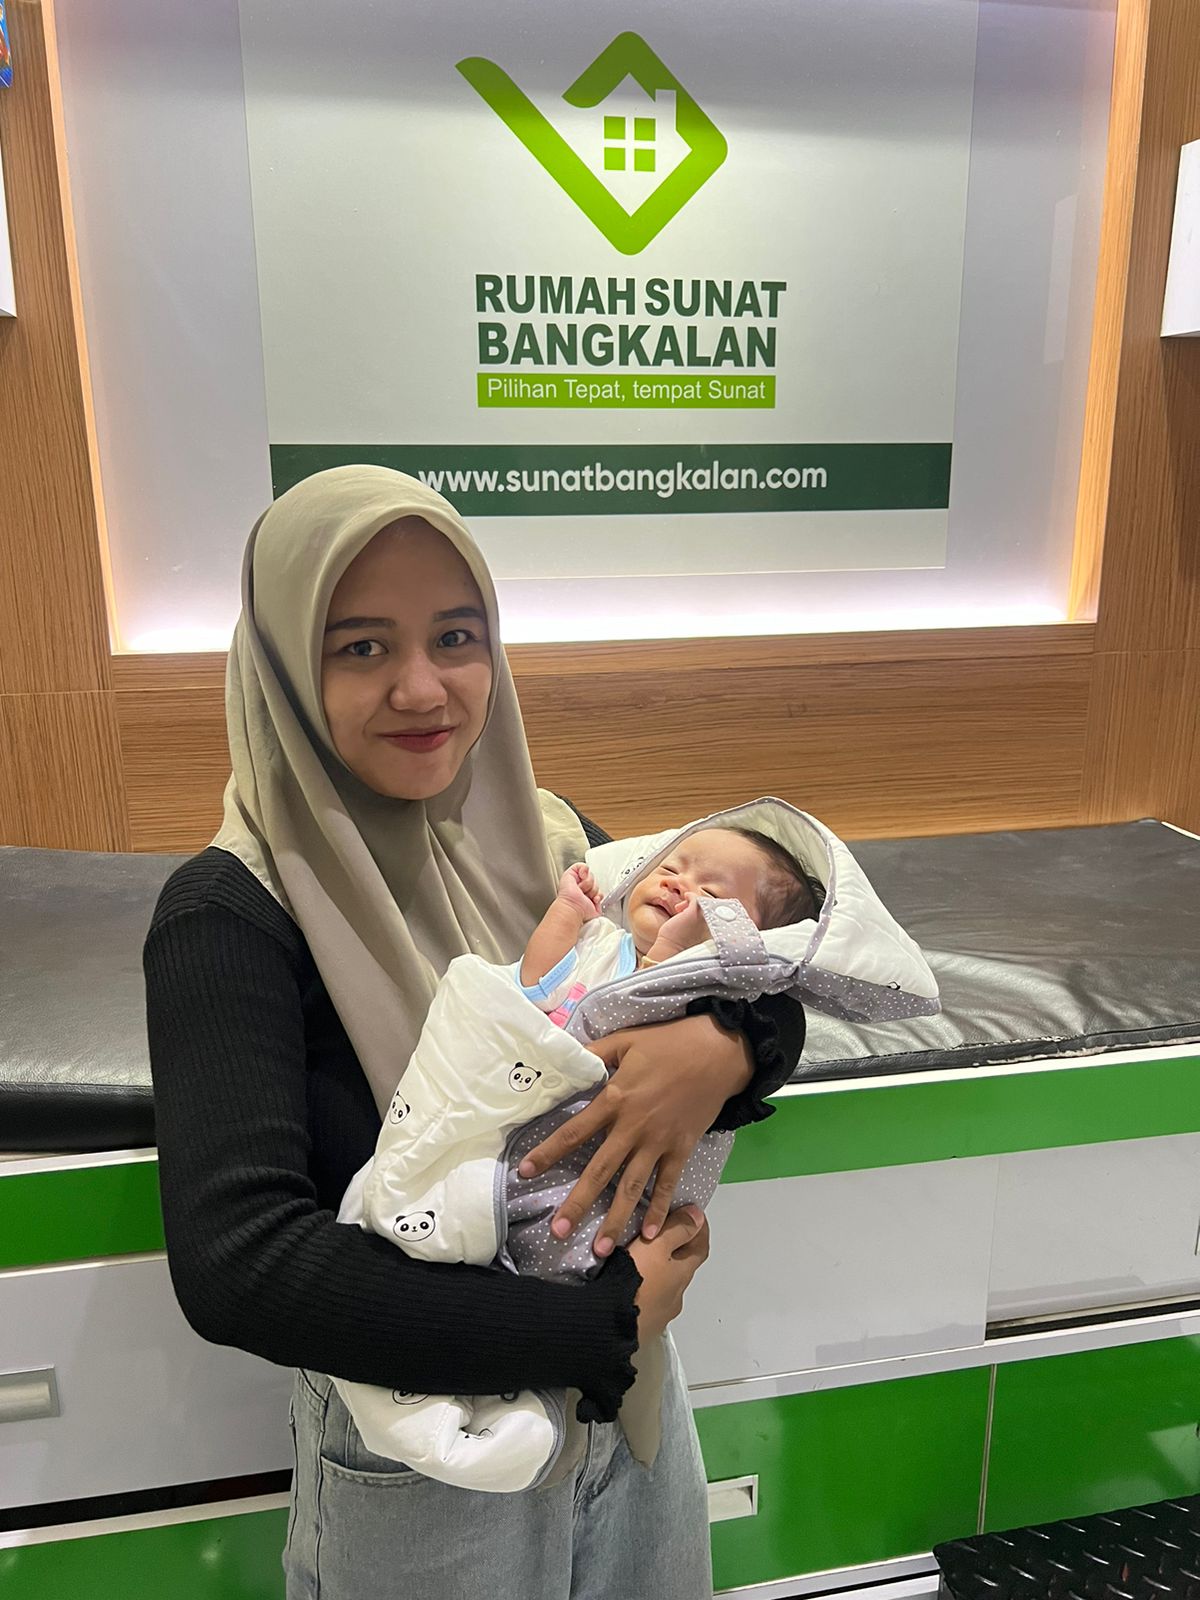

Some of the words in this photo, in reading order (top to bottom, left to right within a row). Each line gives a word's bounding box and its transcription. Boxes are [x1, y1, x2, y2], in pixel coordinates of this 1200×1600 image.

[475, 274, 636, 315] RUMAH
[644, 278, 787, 318] SUNAT
[478, 322, 776, 367] BANGKALAN
[487, 378, 557, 398] Pilihan
[564, 379, 626, 403] Tepat,
[633, 380, 702, 403] tempat
[708, 380, 766, 399] Sunat
[418, 461, 827, 498] www.sunatbangkalan.com
